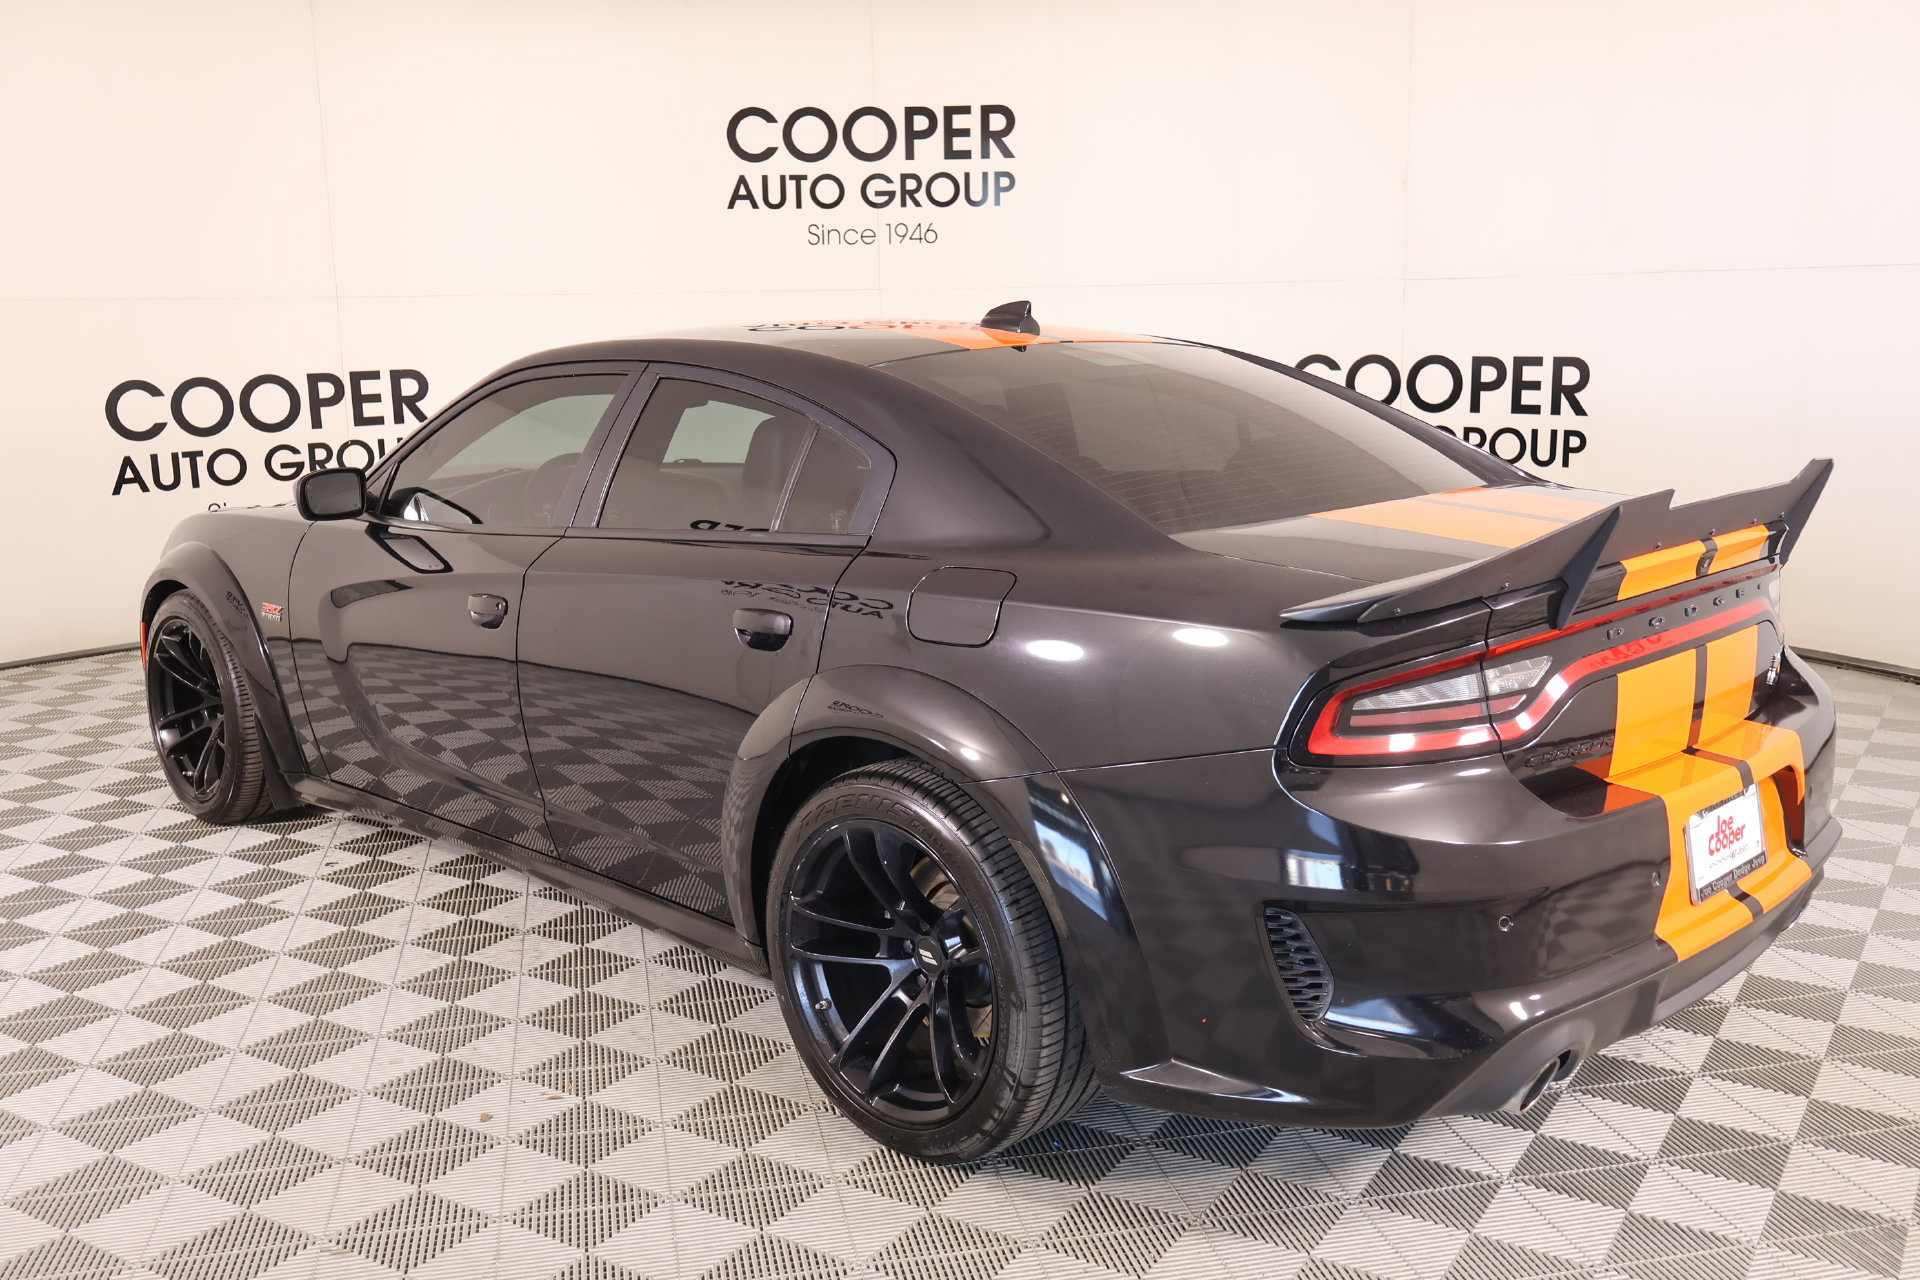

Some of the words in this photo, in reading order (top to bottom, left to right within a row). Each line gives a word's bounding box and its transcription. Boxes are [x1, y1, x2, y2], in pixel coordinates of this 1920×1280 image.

[727, 105, 1016, 163] COOPER
[727, 174, 845, 209] AUTO
[860, 171, 1016, 209] GROUP
[807, 223, 876, 245] Since
[885, 222, 938, 244] 1946
[105, 369, 429, 441] COOPER
[112, 448, 247, 495] AUTO
[264, 438, 401, 481] GRO
[1607, 587, 1747, 641] DODGE
[1708, 823, 1746, 856] Cooper
[1715, 815, 1734, 838] Joe
